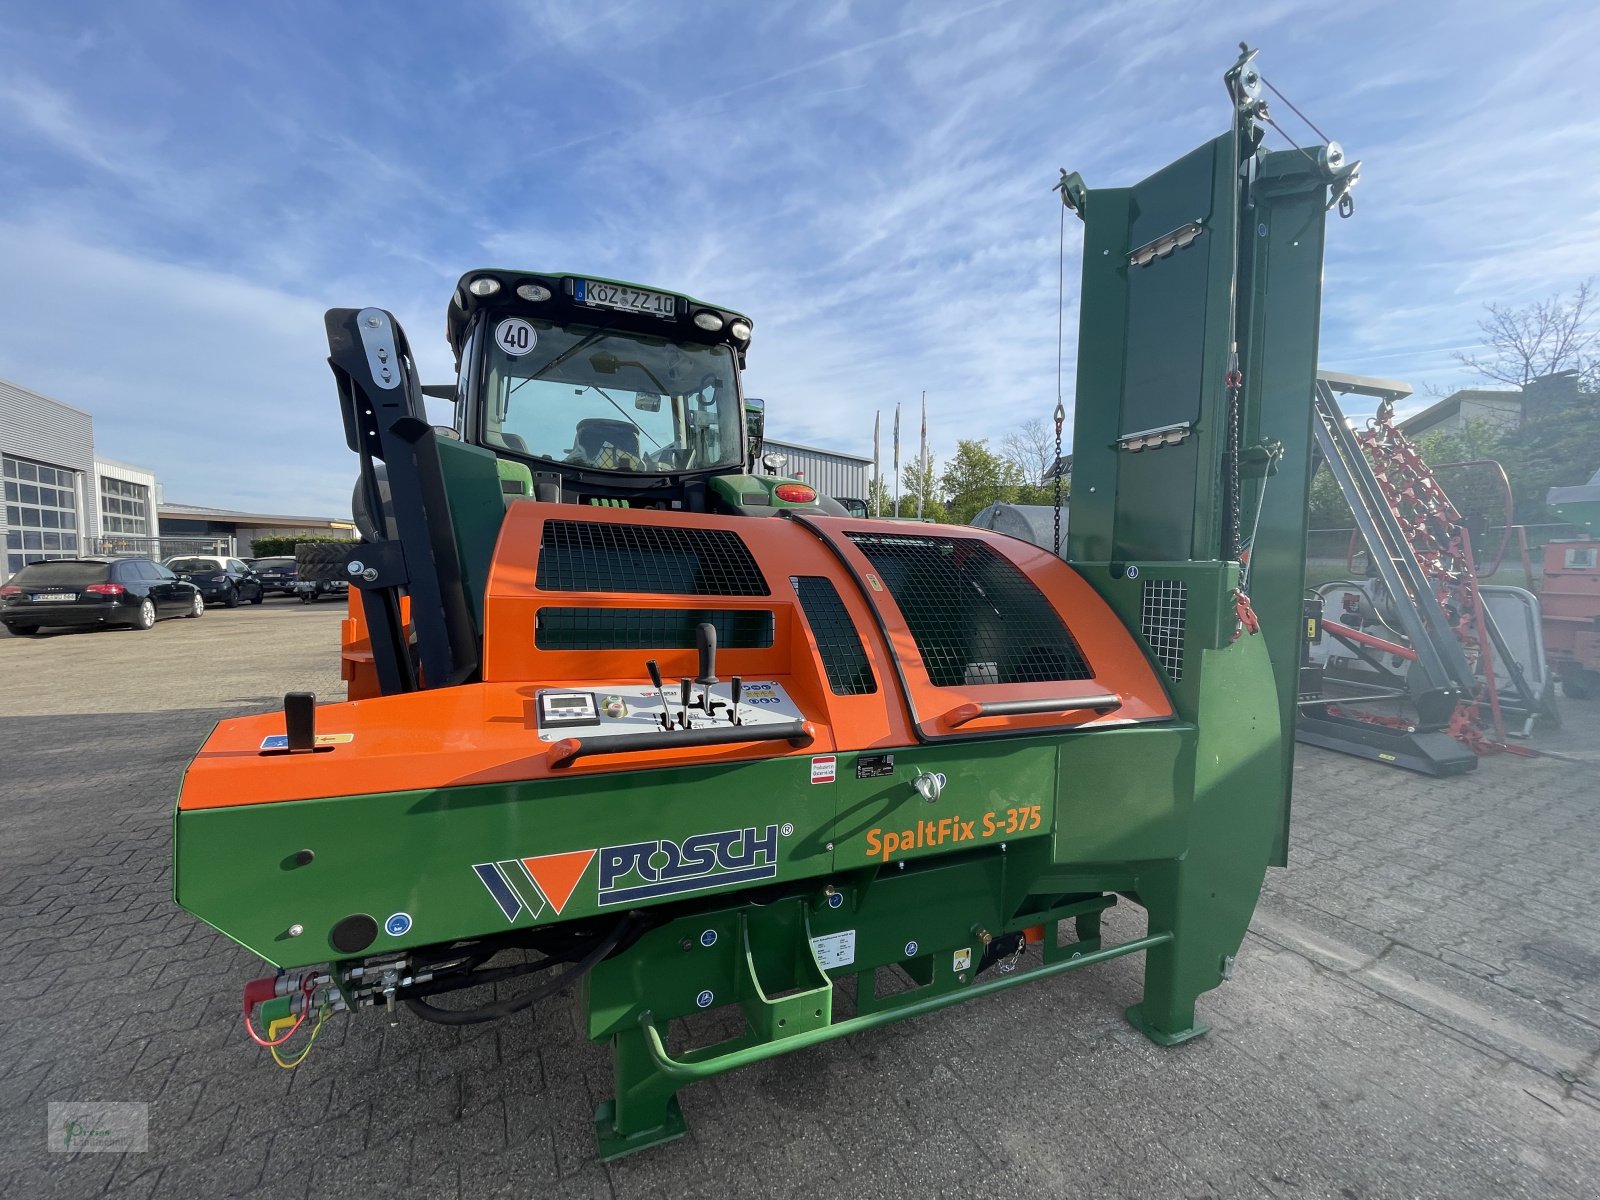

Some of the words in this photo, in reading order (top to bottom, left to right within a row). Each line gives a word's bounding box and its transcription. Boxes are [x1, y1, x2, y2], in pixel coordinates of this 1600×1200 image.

[630, 291, 651, 310] ZZ
[654, 295, 673, 314] 10
[503, 324, 529, 349] 40
[865, 815, 975, 862] SpaltFix
[982, 805, 1042, 837] S-375
